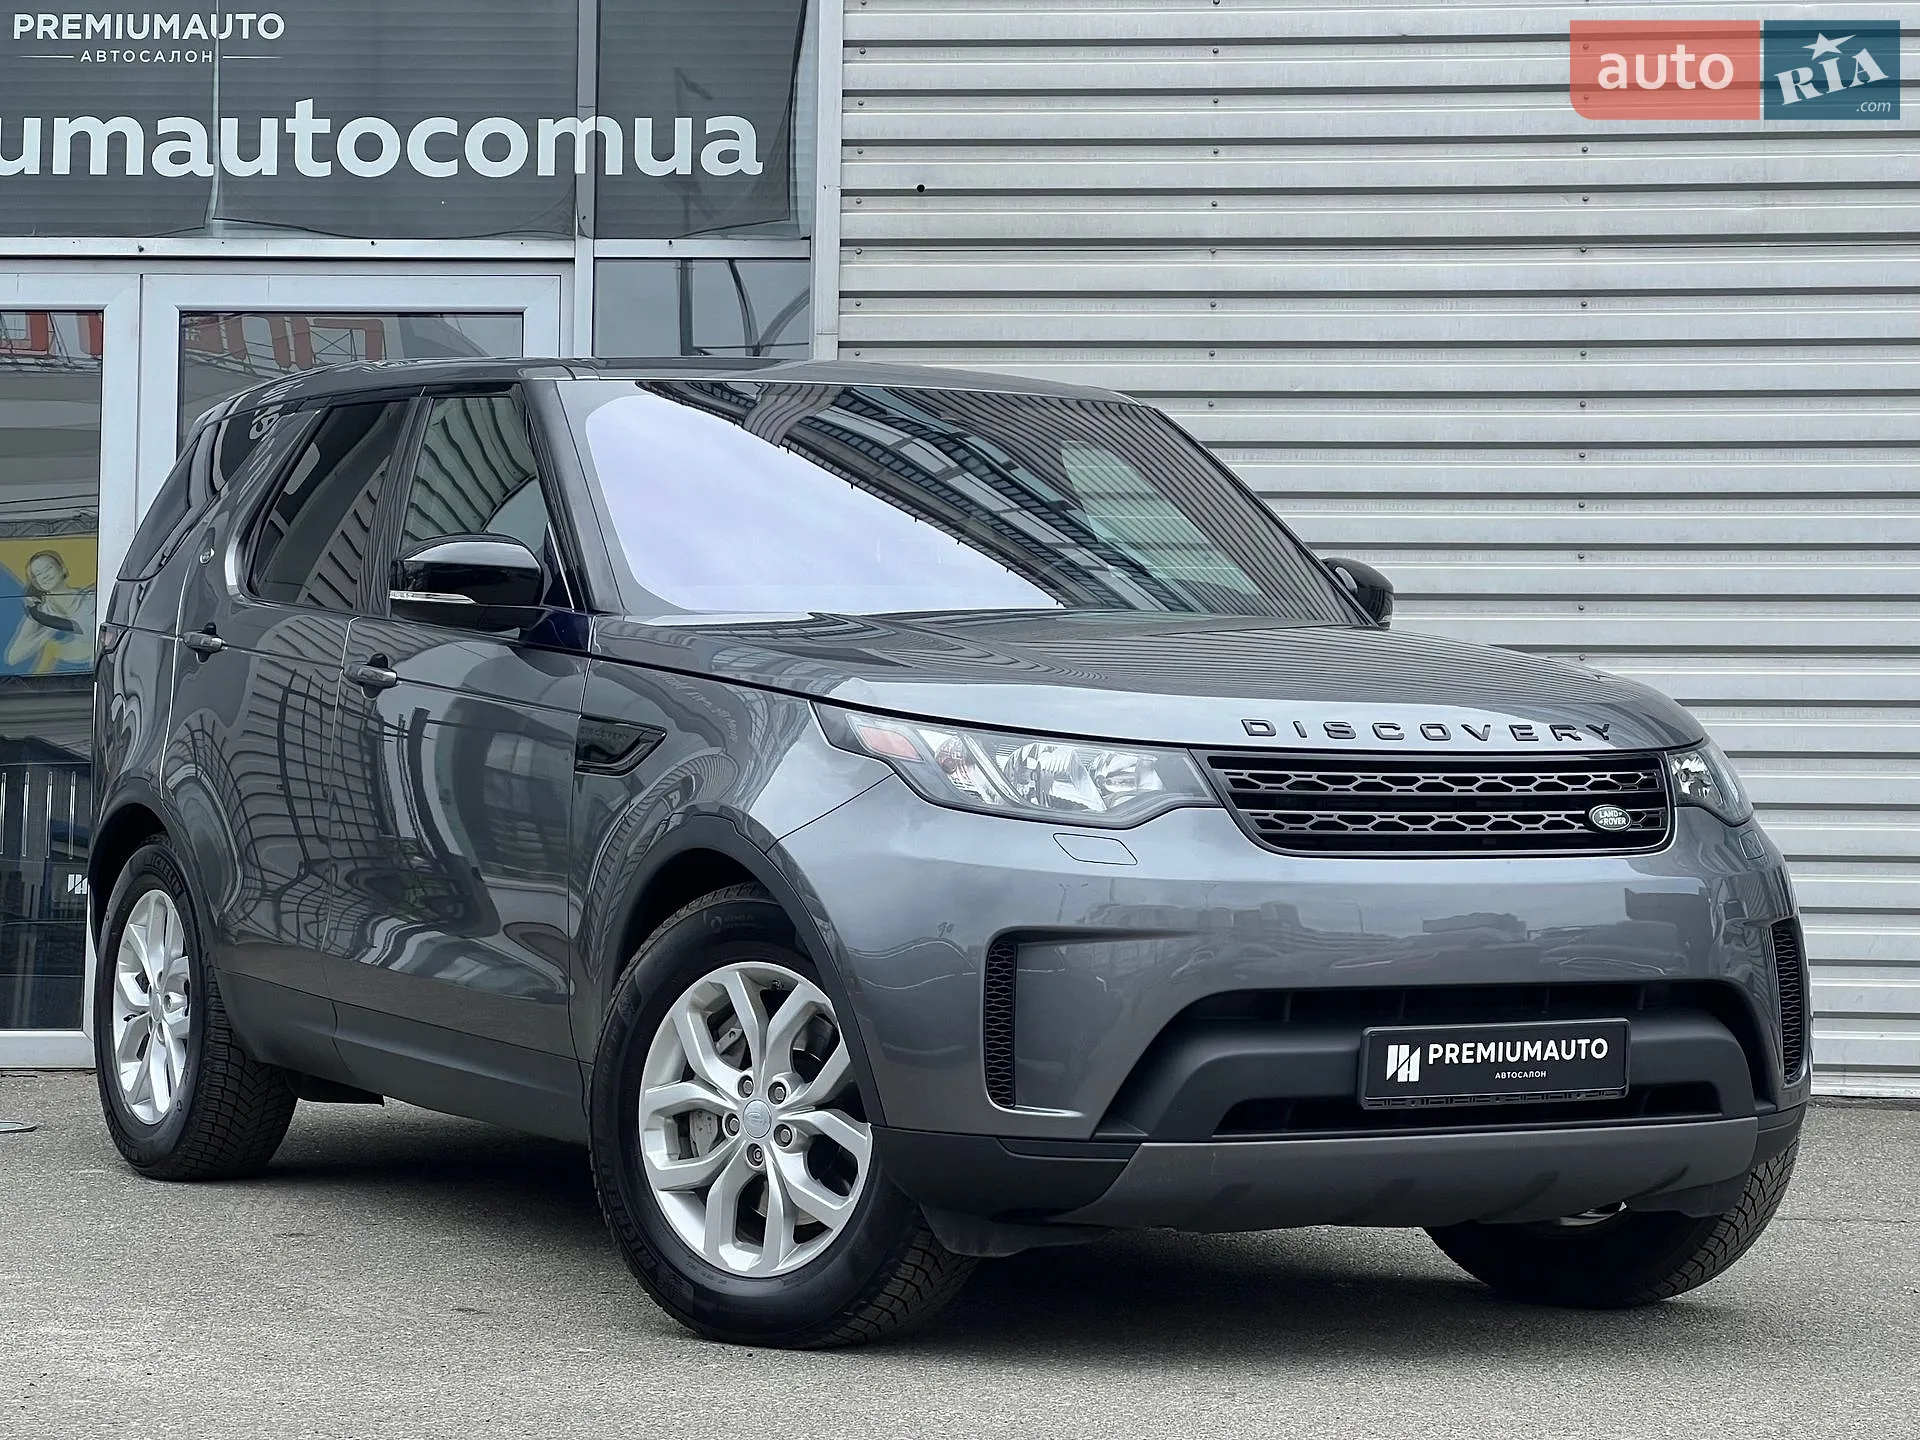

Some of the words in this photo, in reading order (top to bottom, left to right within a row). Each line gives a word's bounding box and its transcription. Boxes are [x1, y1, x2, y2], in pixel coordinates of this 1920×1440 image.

[13, 13, 285, 40] PREMIUMAUTO
[80, 49, 214, 64] АВТОСАЛОН
[1241, 718, 1611, 742] DISCOVERY
[1599, 809, 1619, 818] LAND
[1603, 817, 1627, 826] ROVER
[1428, 1037, 1609, 1065] PREMIUMAUTO
[1495, 1070, 1547, 1080] АВТОСАЛОН
